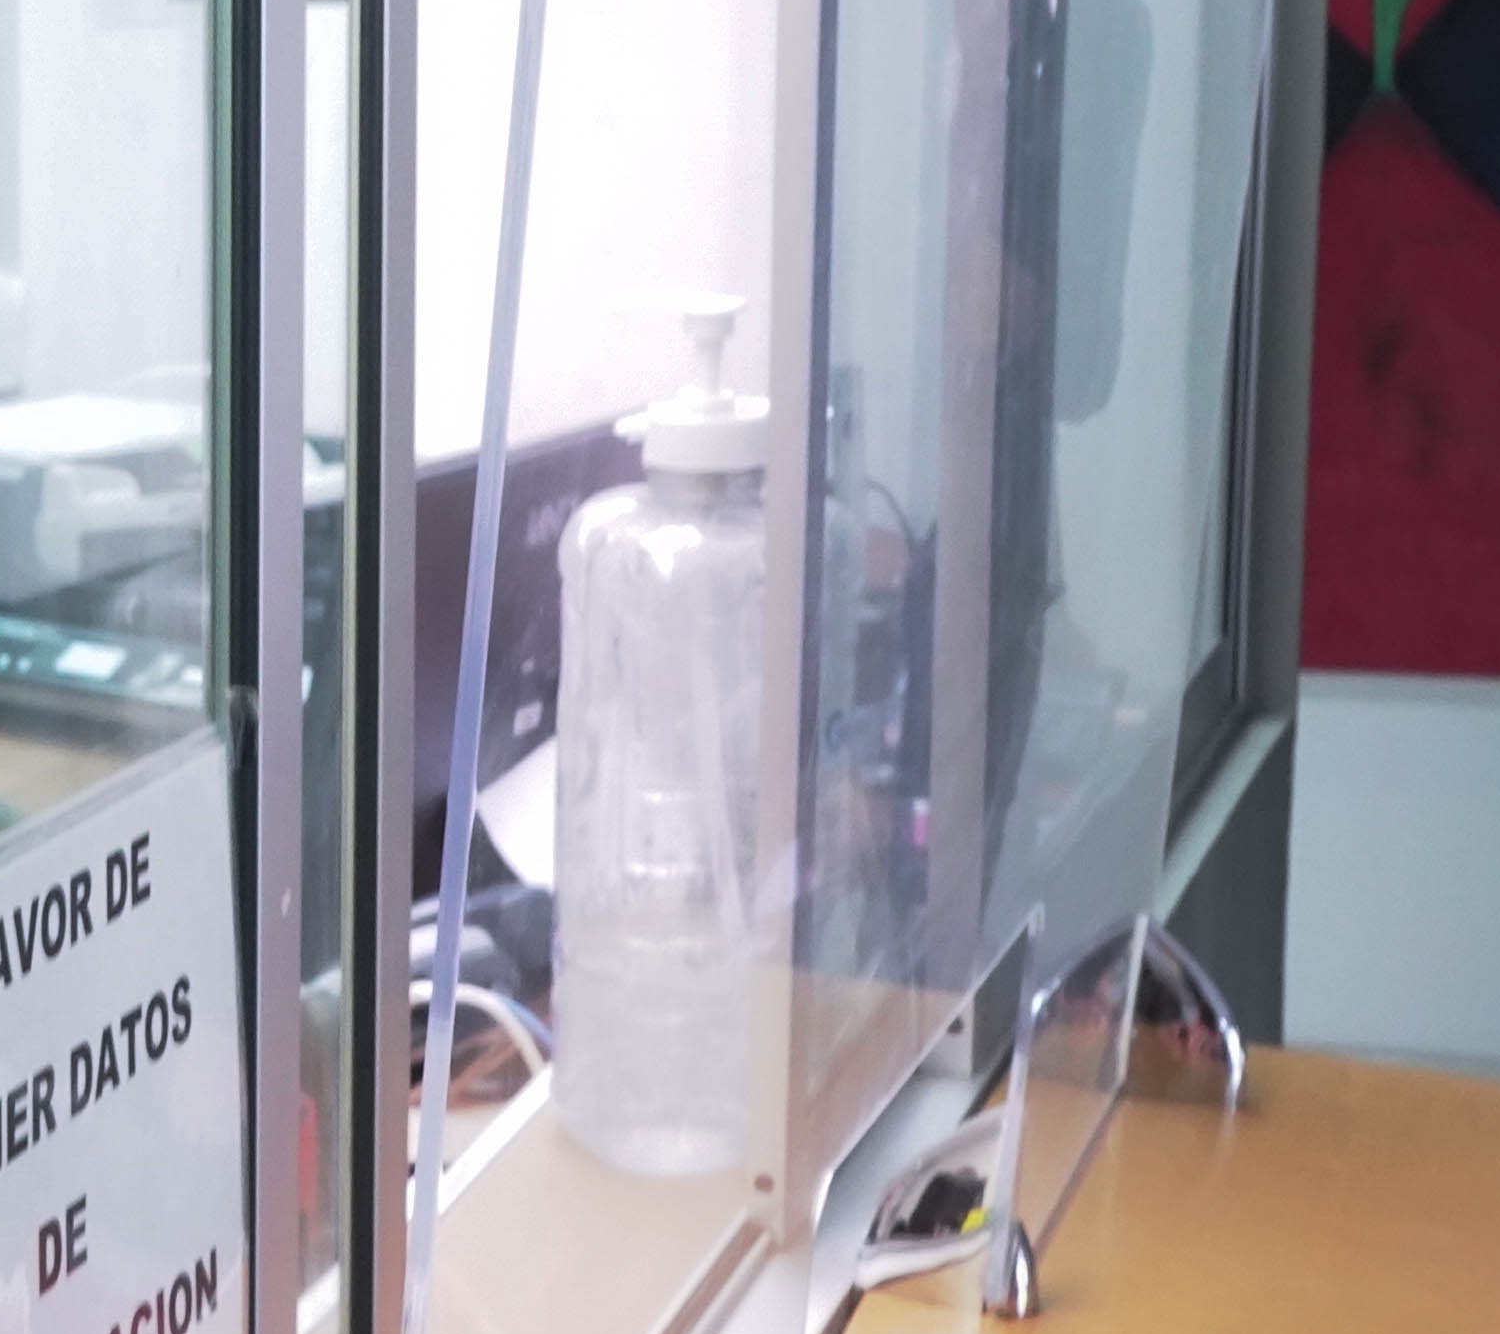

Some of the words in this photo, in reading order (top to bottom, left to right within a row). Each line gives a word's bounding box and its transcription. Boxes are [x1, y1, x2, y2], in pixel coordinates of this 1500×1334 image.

[106, 831, 152, 924] DE
[69, 975, 192, 1119] DATOS
[37, 1194, 89, 1298] DE
